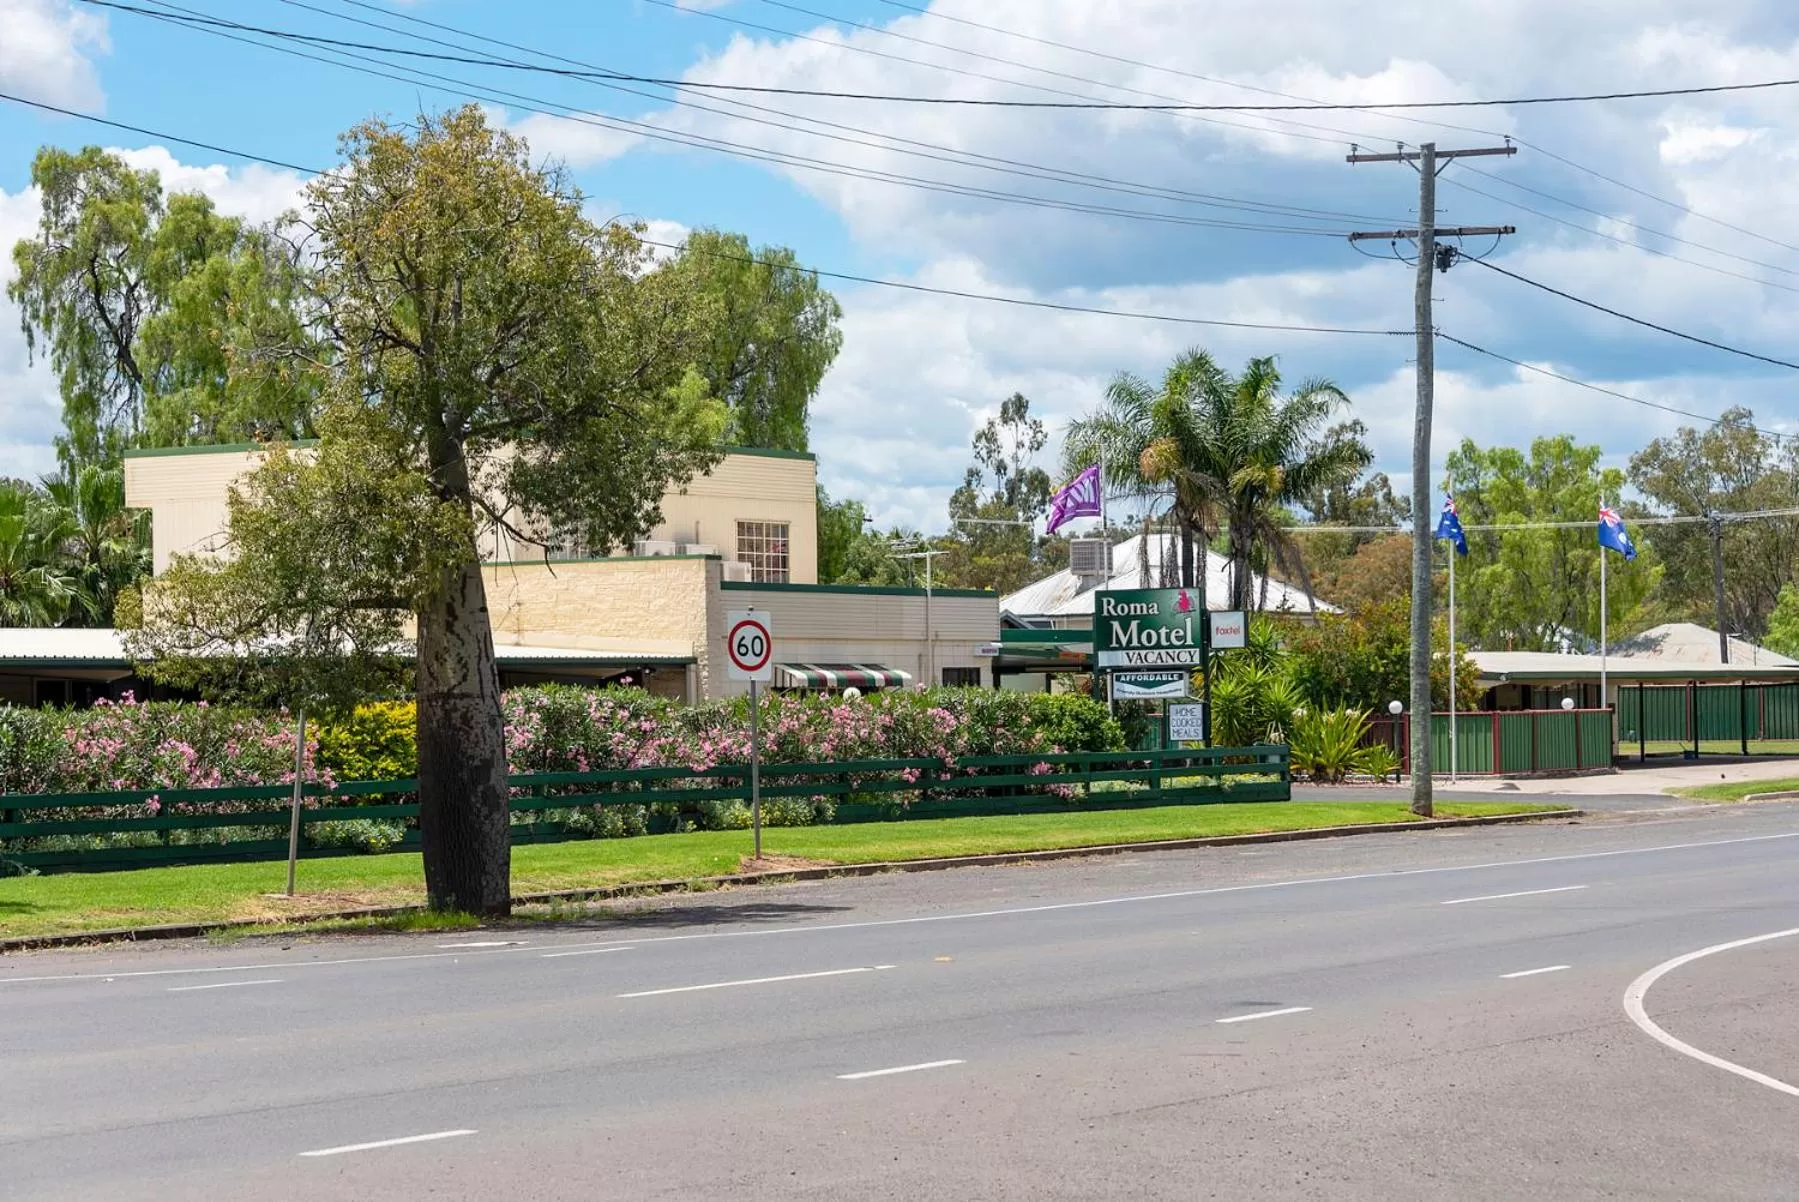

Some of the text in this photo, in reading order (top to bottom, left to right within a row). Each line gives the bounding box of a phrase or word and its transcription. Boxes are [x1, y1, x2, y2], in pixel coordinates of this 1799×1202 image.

[1101, 598, 1159, 617] Roma
[1110, 618, 1194, 648] Motel
[1215, 625, 1241, 635] foxtel
[737, 635, 764, 657] 60
[1125, 650, 1198, 665] VACANCY
[1119, 673, 1179, 682] AFFORDABLE
[1175, 707, 1197, 717] HOME
[1171, 718, 1202, 727] COOKED
[1172, 728, 1199, 738] MEALS
